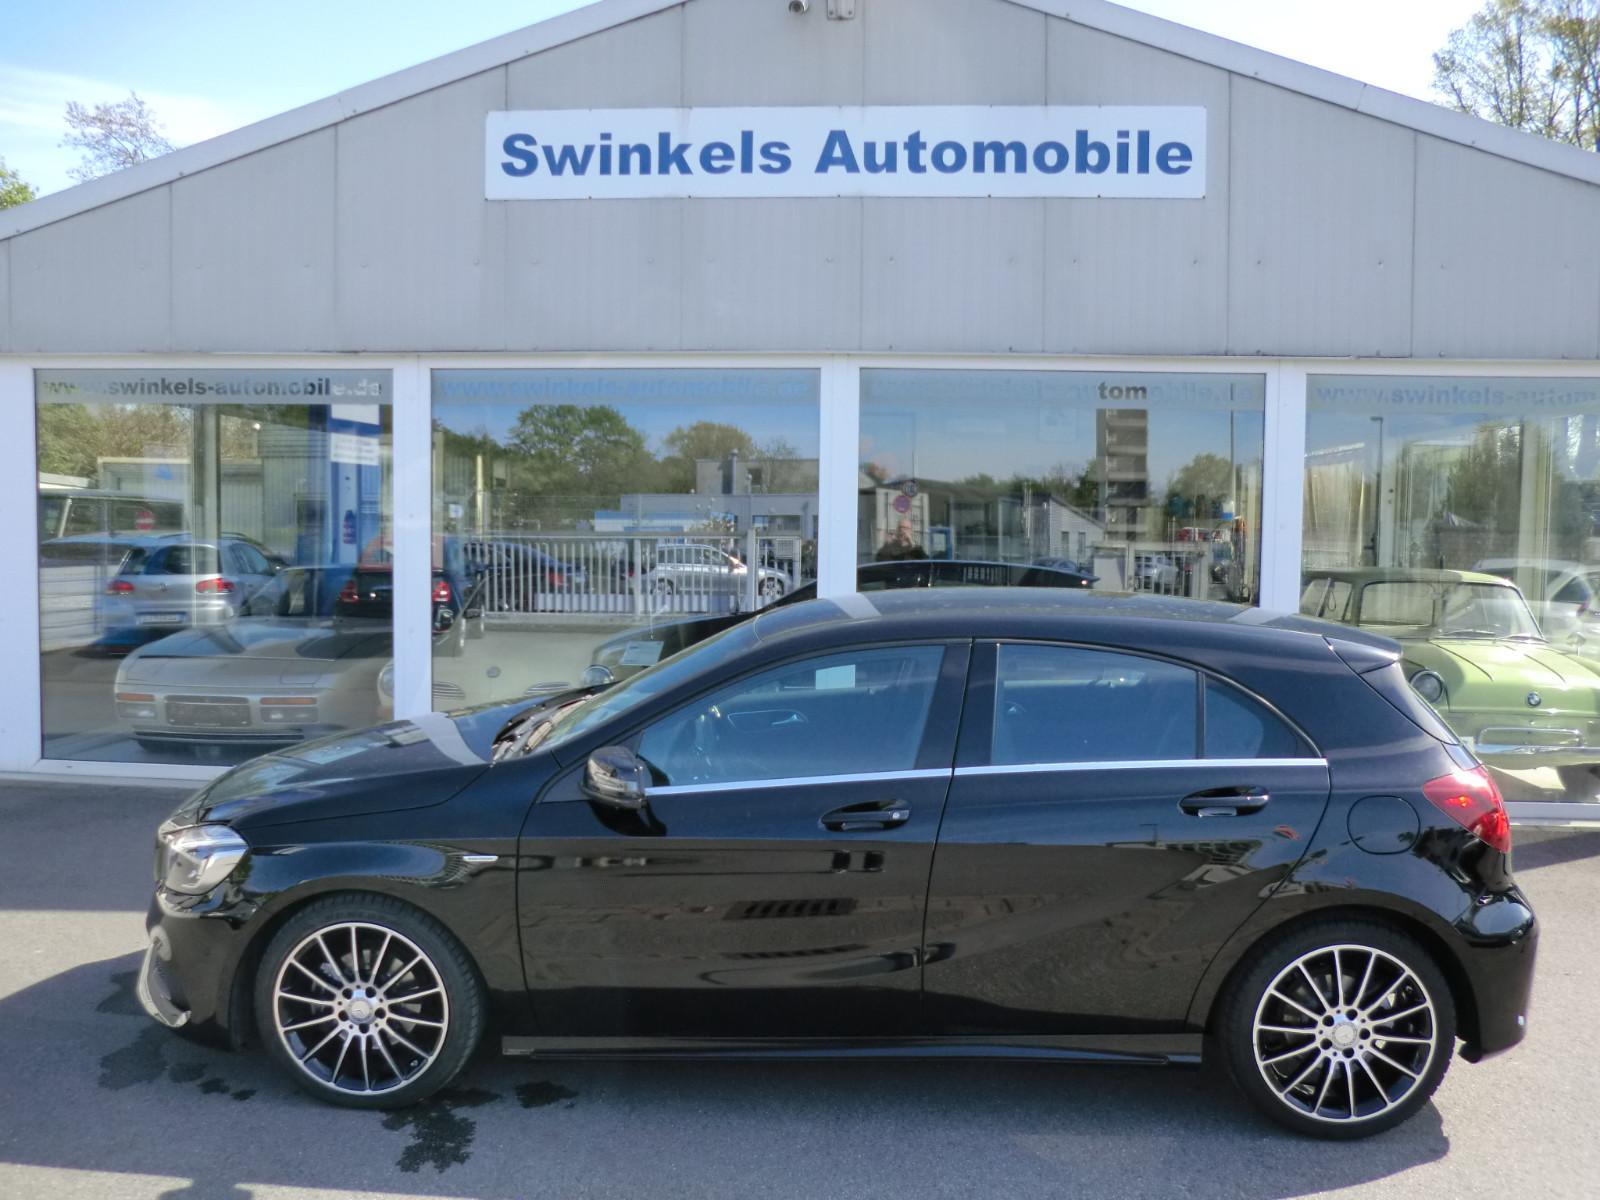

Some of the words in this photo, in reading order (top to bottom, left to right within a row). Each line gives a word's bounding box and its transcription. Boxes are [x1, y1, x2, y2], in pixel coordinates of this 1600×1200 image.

[500, 130, 791, 177] Swinkels
[814, 129, 1192, 175] Automobile
[43, 377, 382, 396] ww.swinkels-automobile.de
